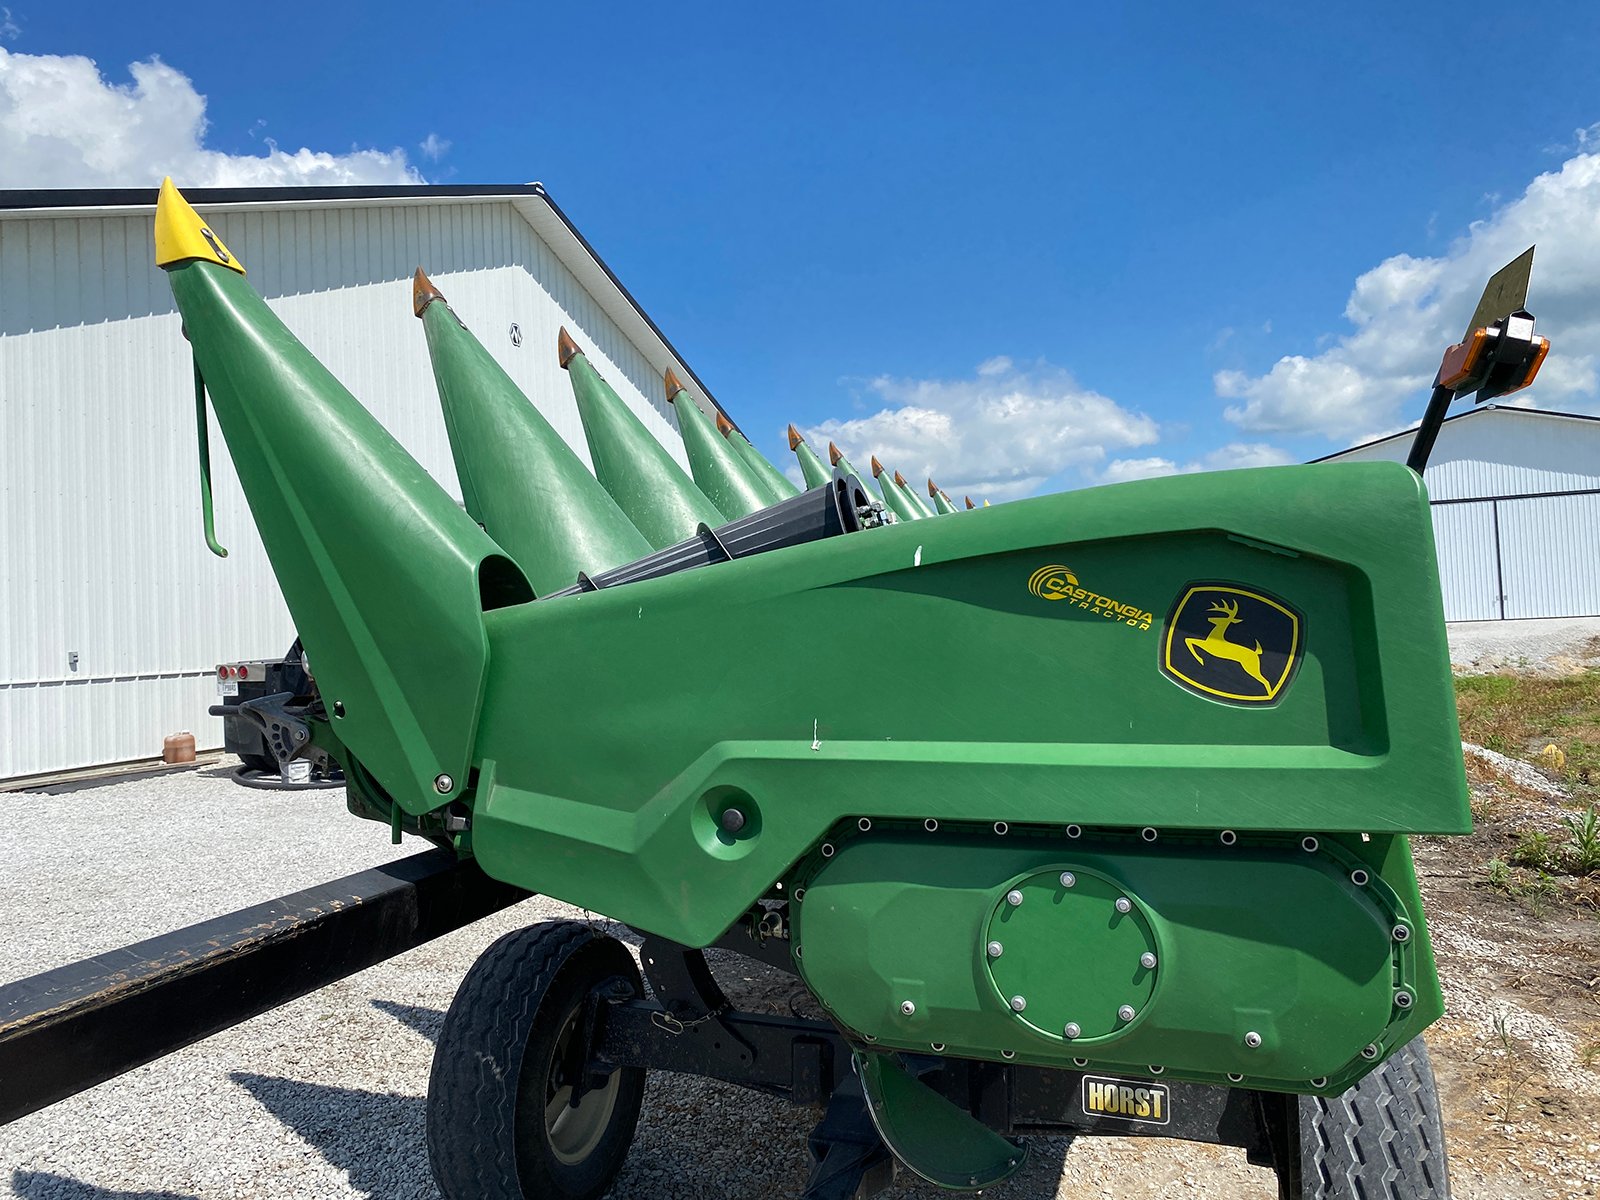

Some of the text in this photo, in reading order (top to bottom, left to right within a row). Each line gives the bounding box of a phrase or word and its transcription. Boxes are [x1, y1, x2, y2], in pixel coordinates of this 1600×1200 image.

[1045, 577, 1153, 624] CASTONGIA
[1069, 597, 1150, 631] TRACTOR
[1088, 1082, 1165, 1118] HORST
